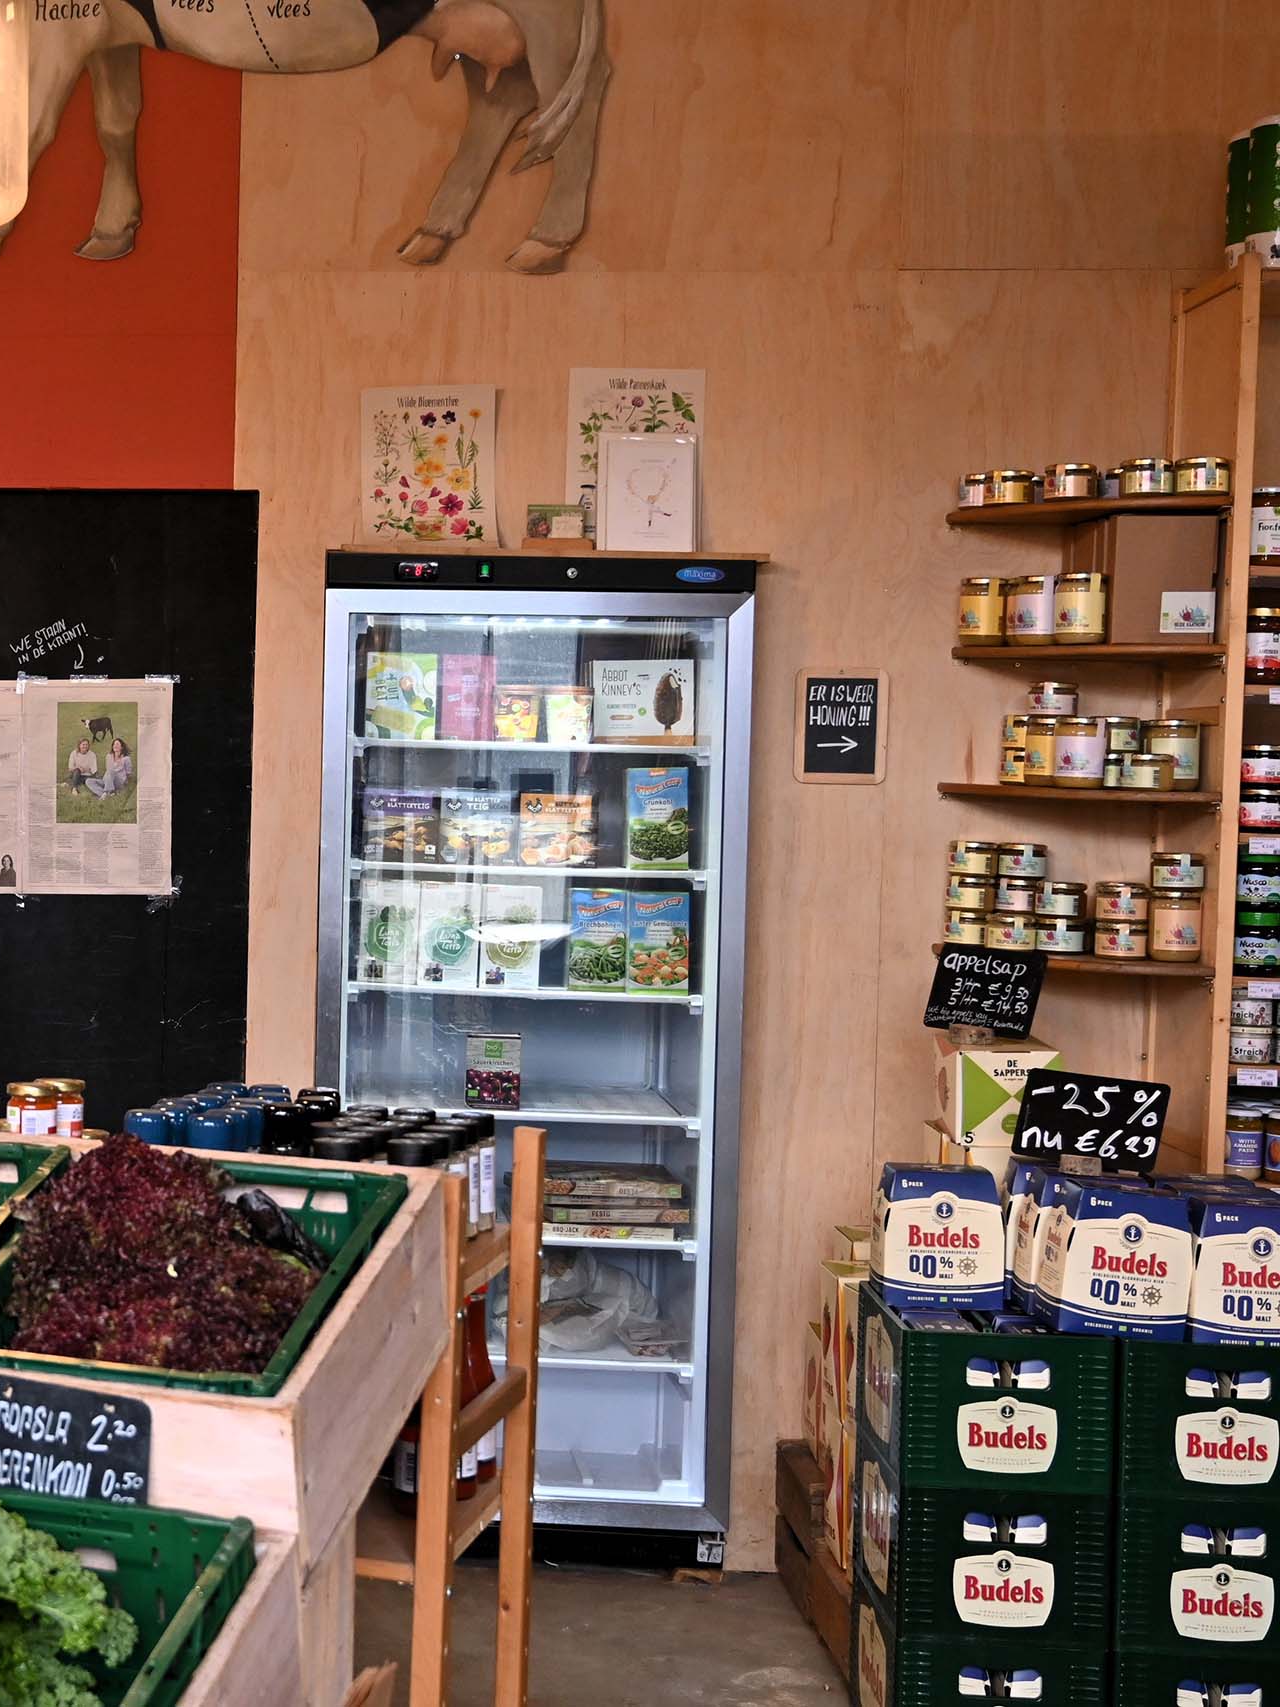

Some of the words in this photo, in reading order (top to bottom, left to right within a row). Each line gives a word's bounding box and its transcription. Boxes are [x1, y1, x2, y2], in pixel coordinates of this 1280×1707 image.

[35, 0, 101, 20] Hachee
[267, 0, 312, 18] vlees
[9, 634, 32, 653] WE
[34, 618, 67, 645] STAAN
[17, 652, 30, 665] IN
[32, 644, 46, 659] DE
[47, 622, 89, 651] KRANT!
[809, 685, 826, 701] ER
[830, 685, 845, 702] IS
[846, 684, 874, 704] WEER
[1243, 878, 1267, 886] Nusco
[1240, 940, 1264, 949] Nusco
[950, 977, 963, 992] 3
[948, 992, 961, 1005] 5
[1231, 1011, 1255, 1020] treich
[1234, 1047, 1264, 1056] Streich
[994, 1068, 1031, 1077] SAPPERS
[1007, 1060, 1018, 1068] DE
[964, 1132, 974, 1144] 5
[1021, 1126, 1063, 1150] nu
[902, 1179, 908, 1188] 6
[1090, 1197, 1097, 1207] 6
[1097, 1199, 1113, 1207] PACK
[1215, 1213, 1221, 1222] 6
[908, 1224, 980, 1249] Budels
[1091, 1246, 1168, 1278] Budels
[1222, 1262, 1280, 1289] Bude
[968, 1422, 1048, 1450] Budels
[1186, 1432, 1269, 1462] Budels
[964, 1575, 1044, 1603] Budels
[1182, 1588, 1265, 1618] Budels
